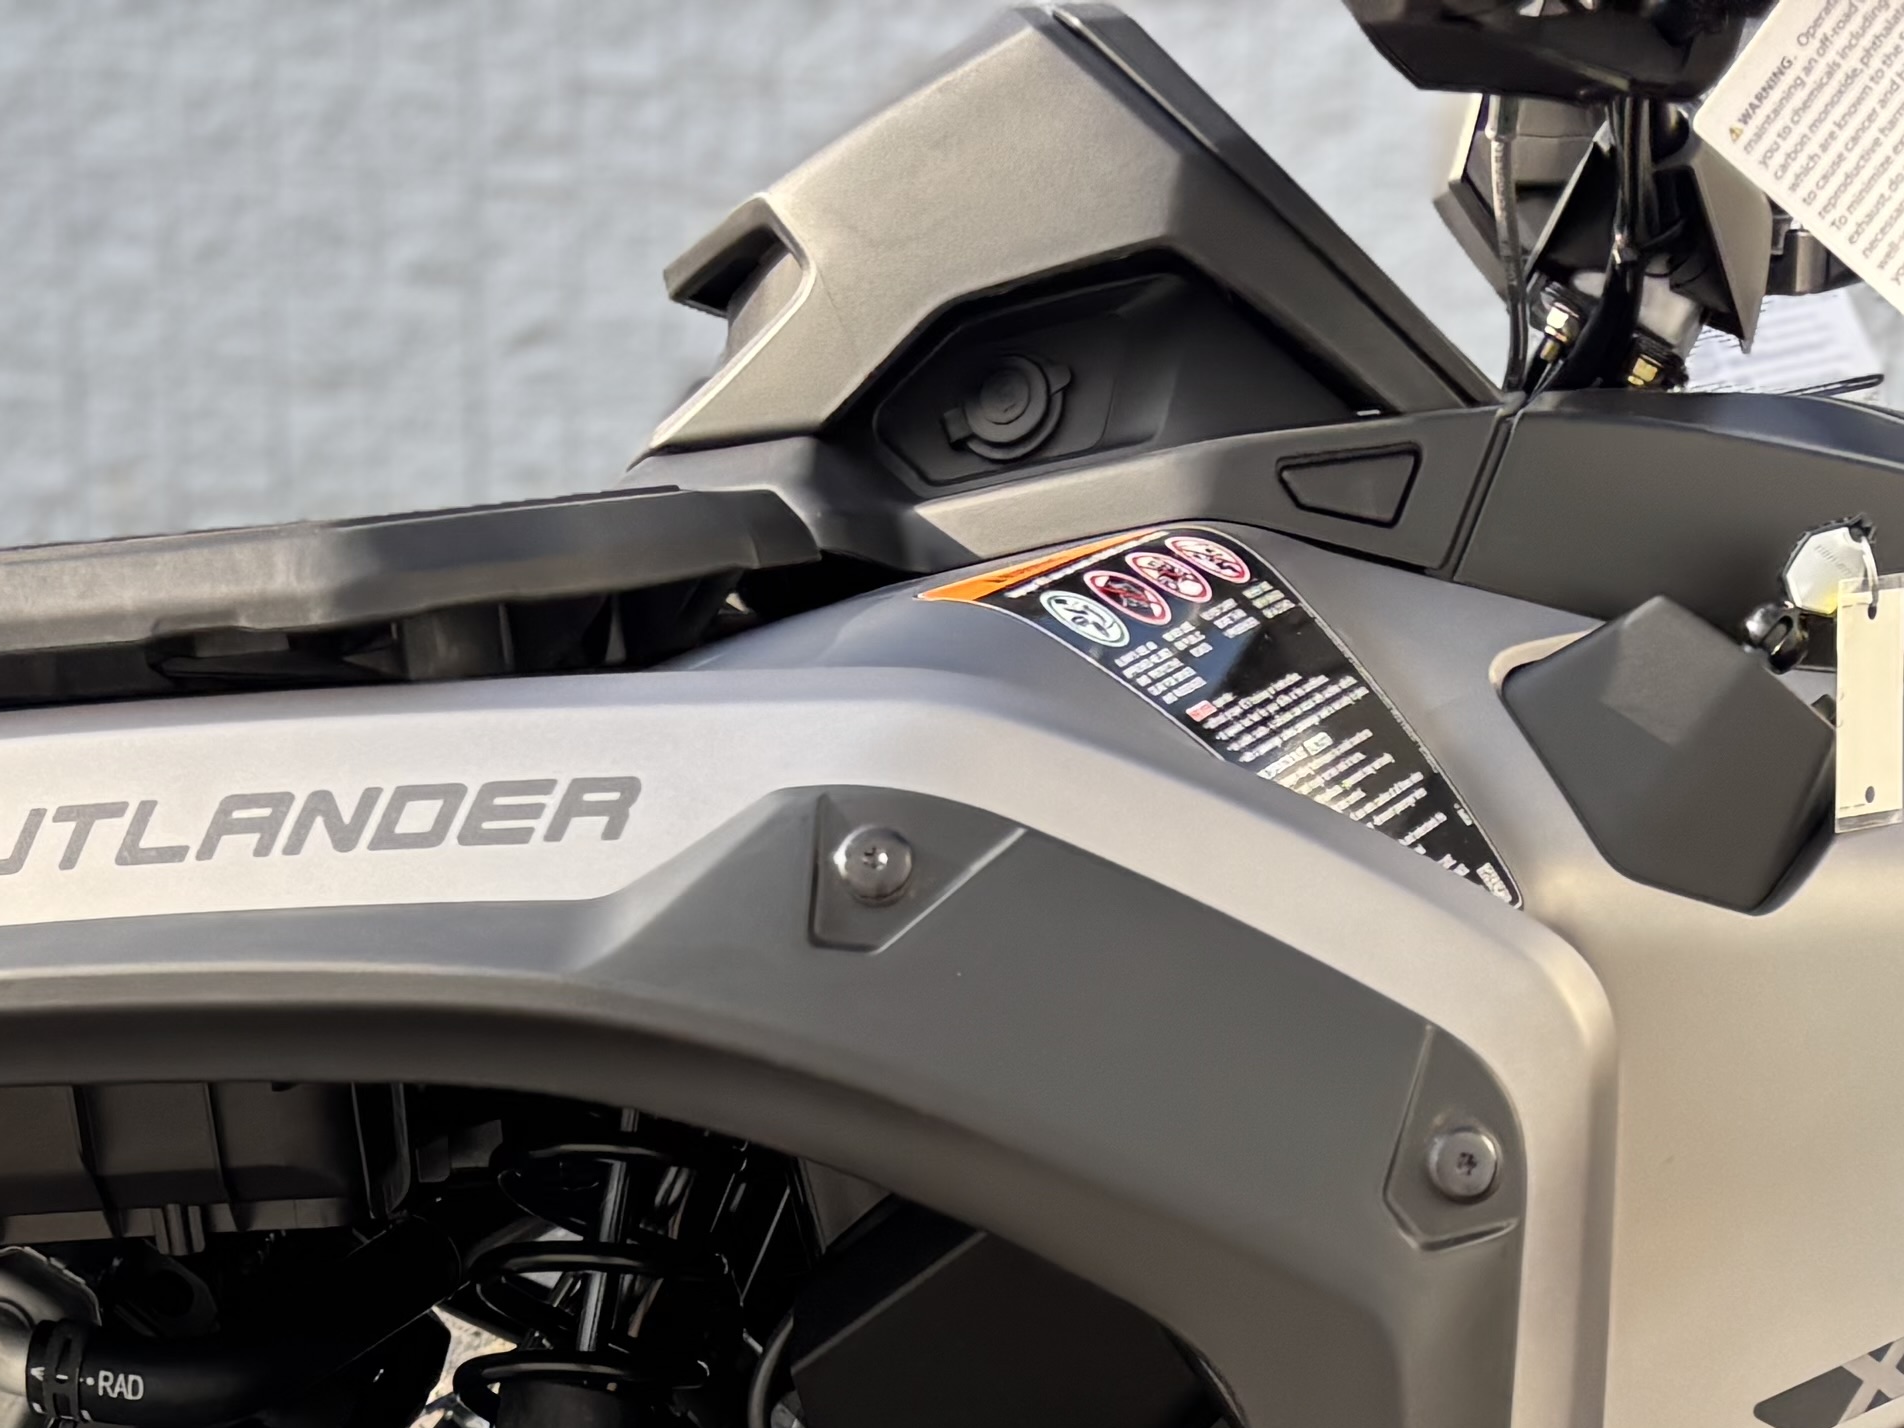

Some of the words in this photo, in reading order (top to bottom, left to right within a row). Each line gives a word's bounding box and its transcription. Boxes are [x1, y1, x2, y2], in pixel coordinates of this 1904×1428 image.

[1739, 73, 1808, 157] maintaining
[1799, 56, 1819, 77] an
[1811, 0, 1859, 58] off-road
[1756, 140, 1784, 171] you
[1775, 123, 1793, 142] to
[1785, 57, 1842, 126] chemicals
[1784, 149, 1822, 194] which
[1817, 128, 1839, 153] are
[1832, 81, 1873, 131] known
[1867, 65, 1886, 86] to
[1879, 41, 1904, 69] the
[1771, 131, 1812, 181] carbon
[1801, 188, 1819, 207] to
[1813, 150, 1848, 192] cause
[1842, 106, 1882, 154] cancer
[1873, 78, 1901, 110] and
[1814, 133, 1885, 221] reproductive
[1829, 211, 1849, 232] To
[1843, 152, 1895, 216] minimize
[97, 1371, 144, 1400] RAD
